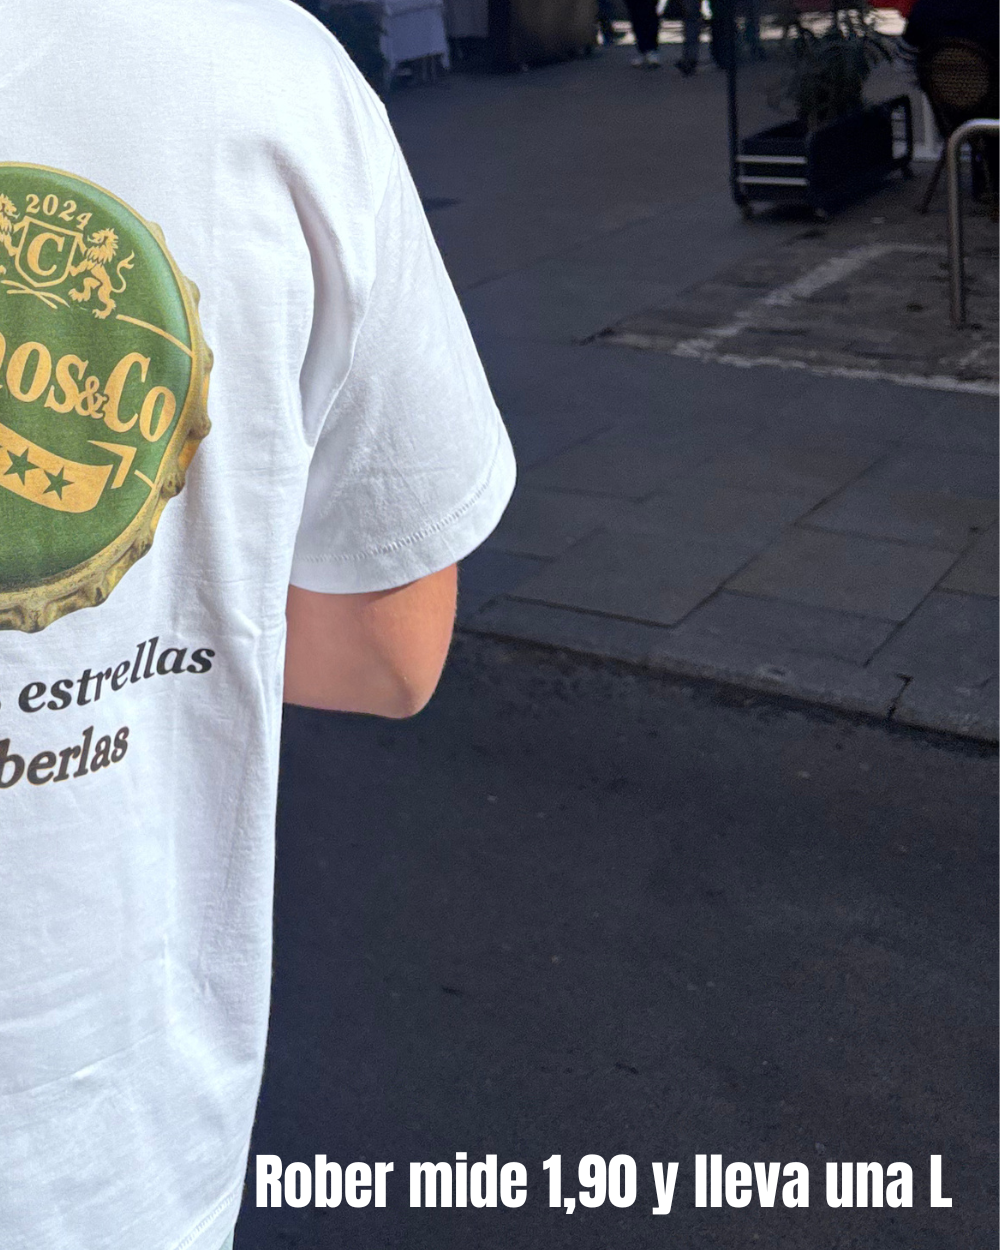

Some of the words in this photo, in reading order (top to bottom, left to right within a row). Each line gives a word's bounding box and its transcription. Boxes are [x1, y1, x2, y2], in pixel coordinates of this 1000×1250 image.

[25, 193, 93, 230] 2024
[26, 232, 64, 277] C
[17, 636, 216, 713] estrellas
